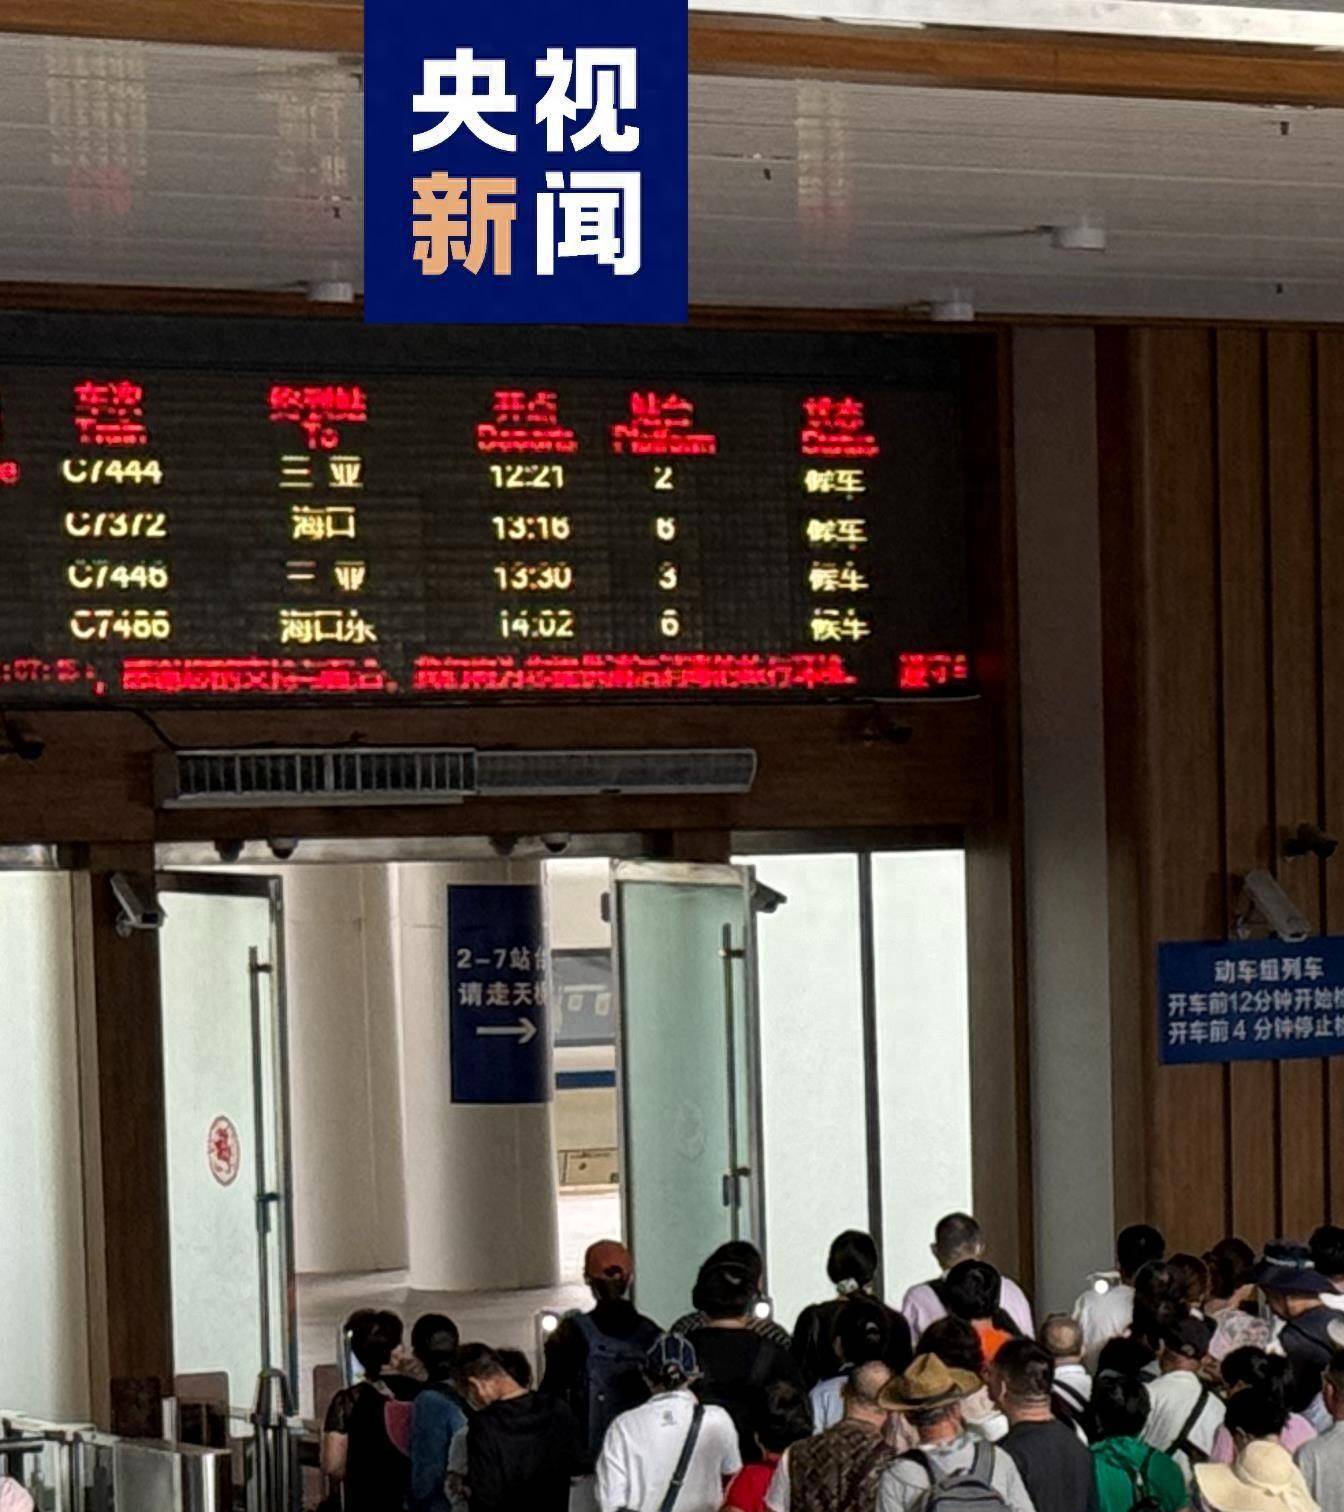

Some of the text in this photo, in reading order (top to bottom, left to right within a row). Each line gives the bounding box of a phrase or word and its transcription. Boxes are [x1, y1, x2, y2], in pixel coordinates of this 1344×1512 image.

[62, 459, 163, 484] C7444
[490, 465, 564, 488] 12:21
[65, 510, 167, 537] C7372
[291, 506, 356, 538] 海口
[495, 563, 572, 589] 13:30
[279, 609, 377, 643] 海口东
[501, 610, 573, 637] 14:02
[1214, 956, 1325, 983] 动车组列车
